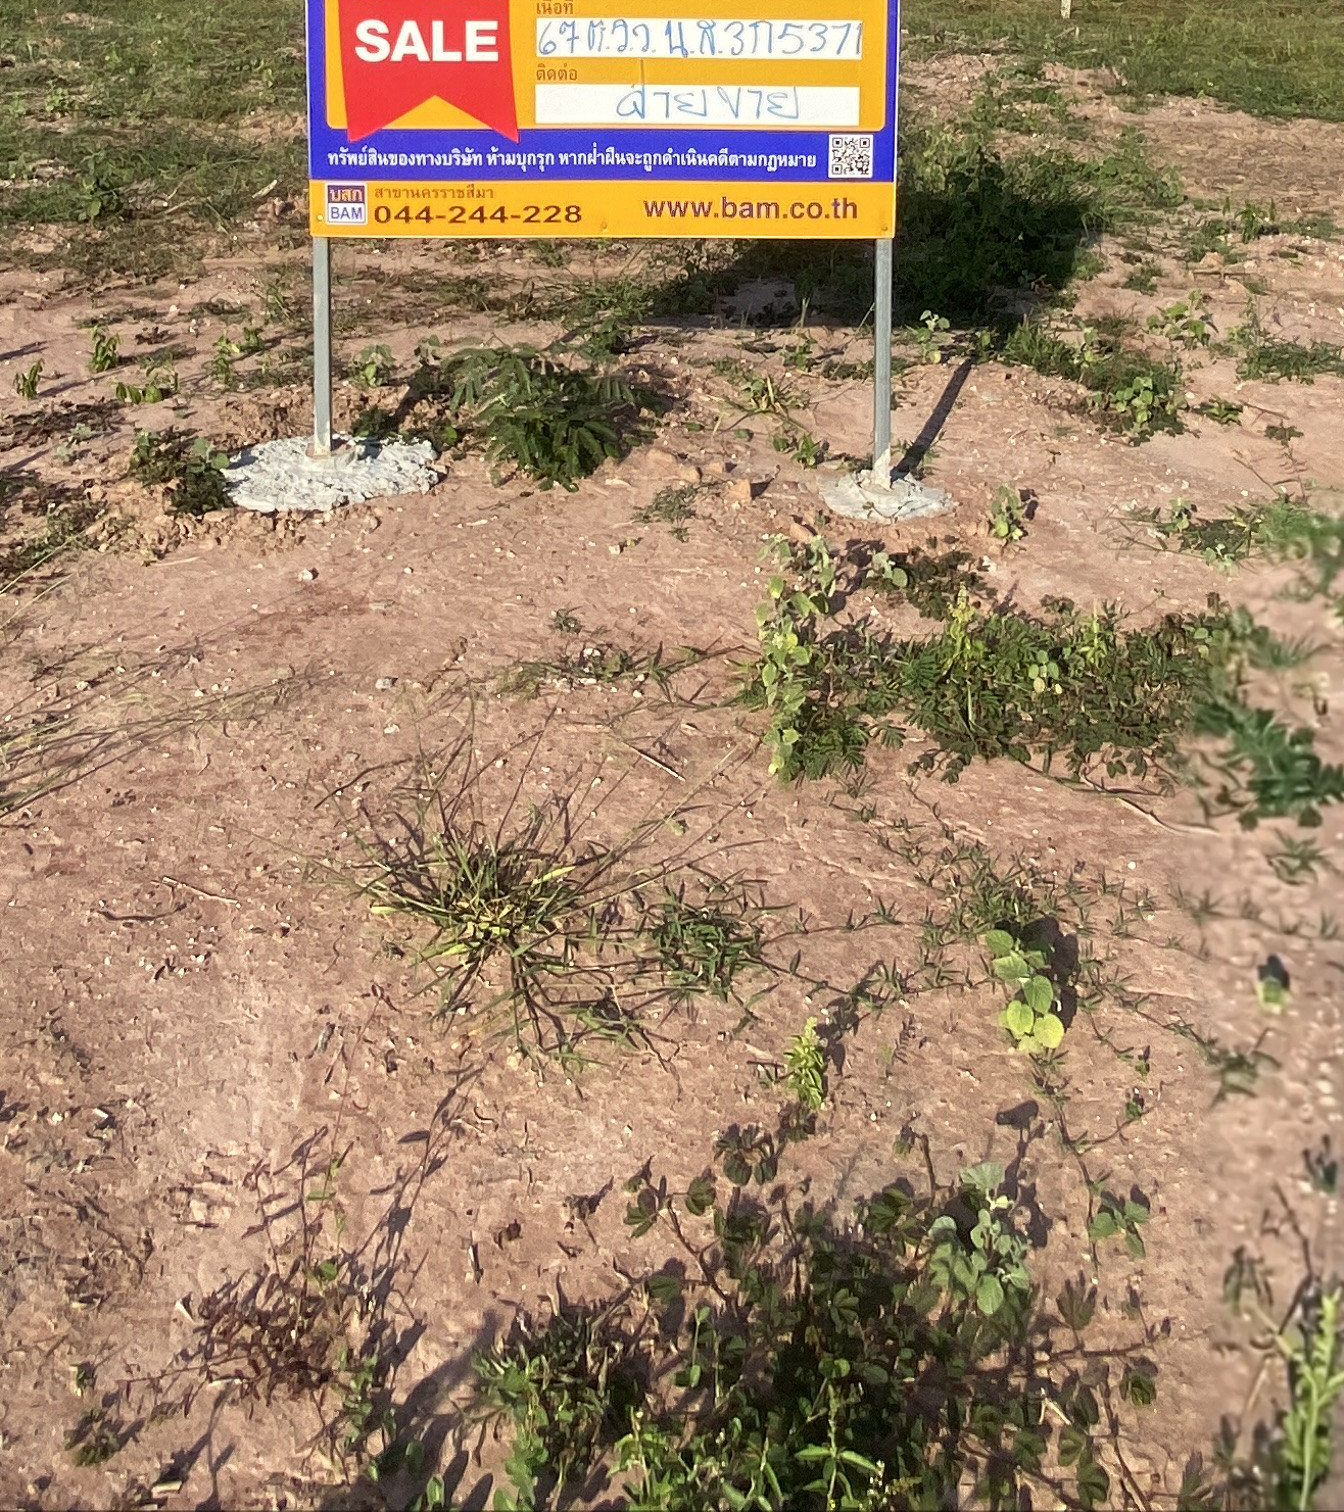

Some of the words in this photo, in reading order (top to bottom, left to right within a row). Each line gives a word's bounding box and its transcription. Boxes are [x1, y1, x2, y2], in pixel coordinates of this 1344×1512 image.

[354, 19, 500, 63] SALE
[535, 63, 578, 82] ติดต่อ
[327, 145, 483, 167] ทรัพย์สินของทางบริษัท
[487, 146, 555, 172] ห้ามบุกรุก
[374, 183, 495, 199] สาขานครราชสีมา
[330, 206, 362, 220] BAM
[373, 204, 583, 224] 044-244-228
[643, 196, 858, 220] www.bam.co.th
